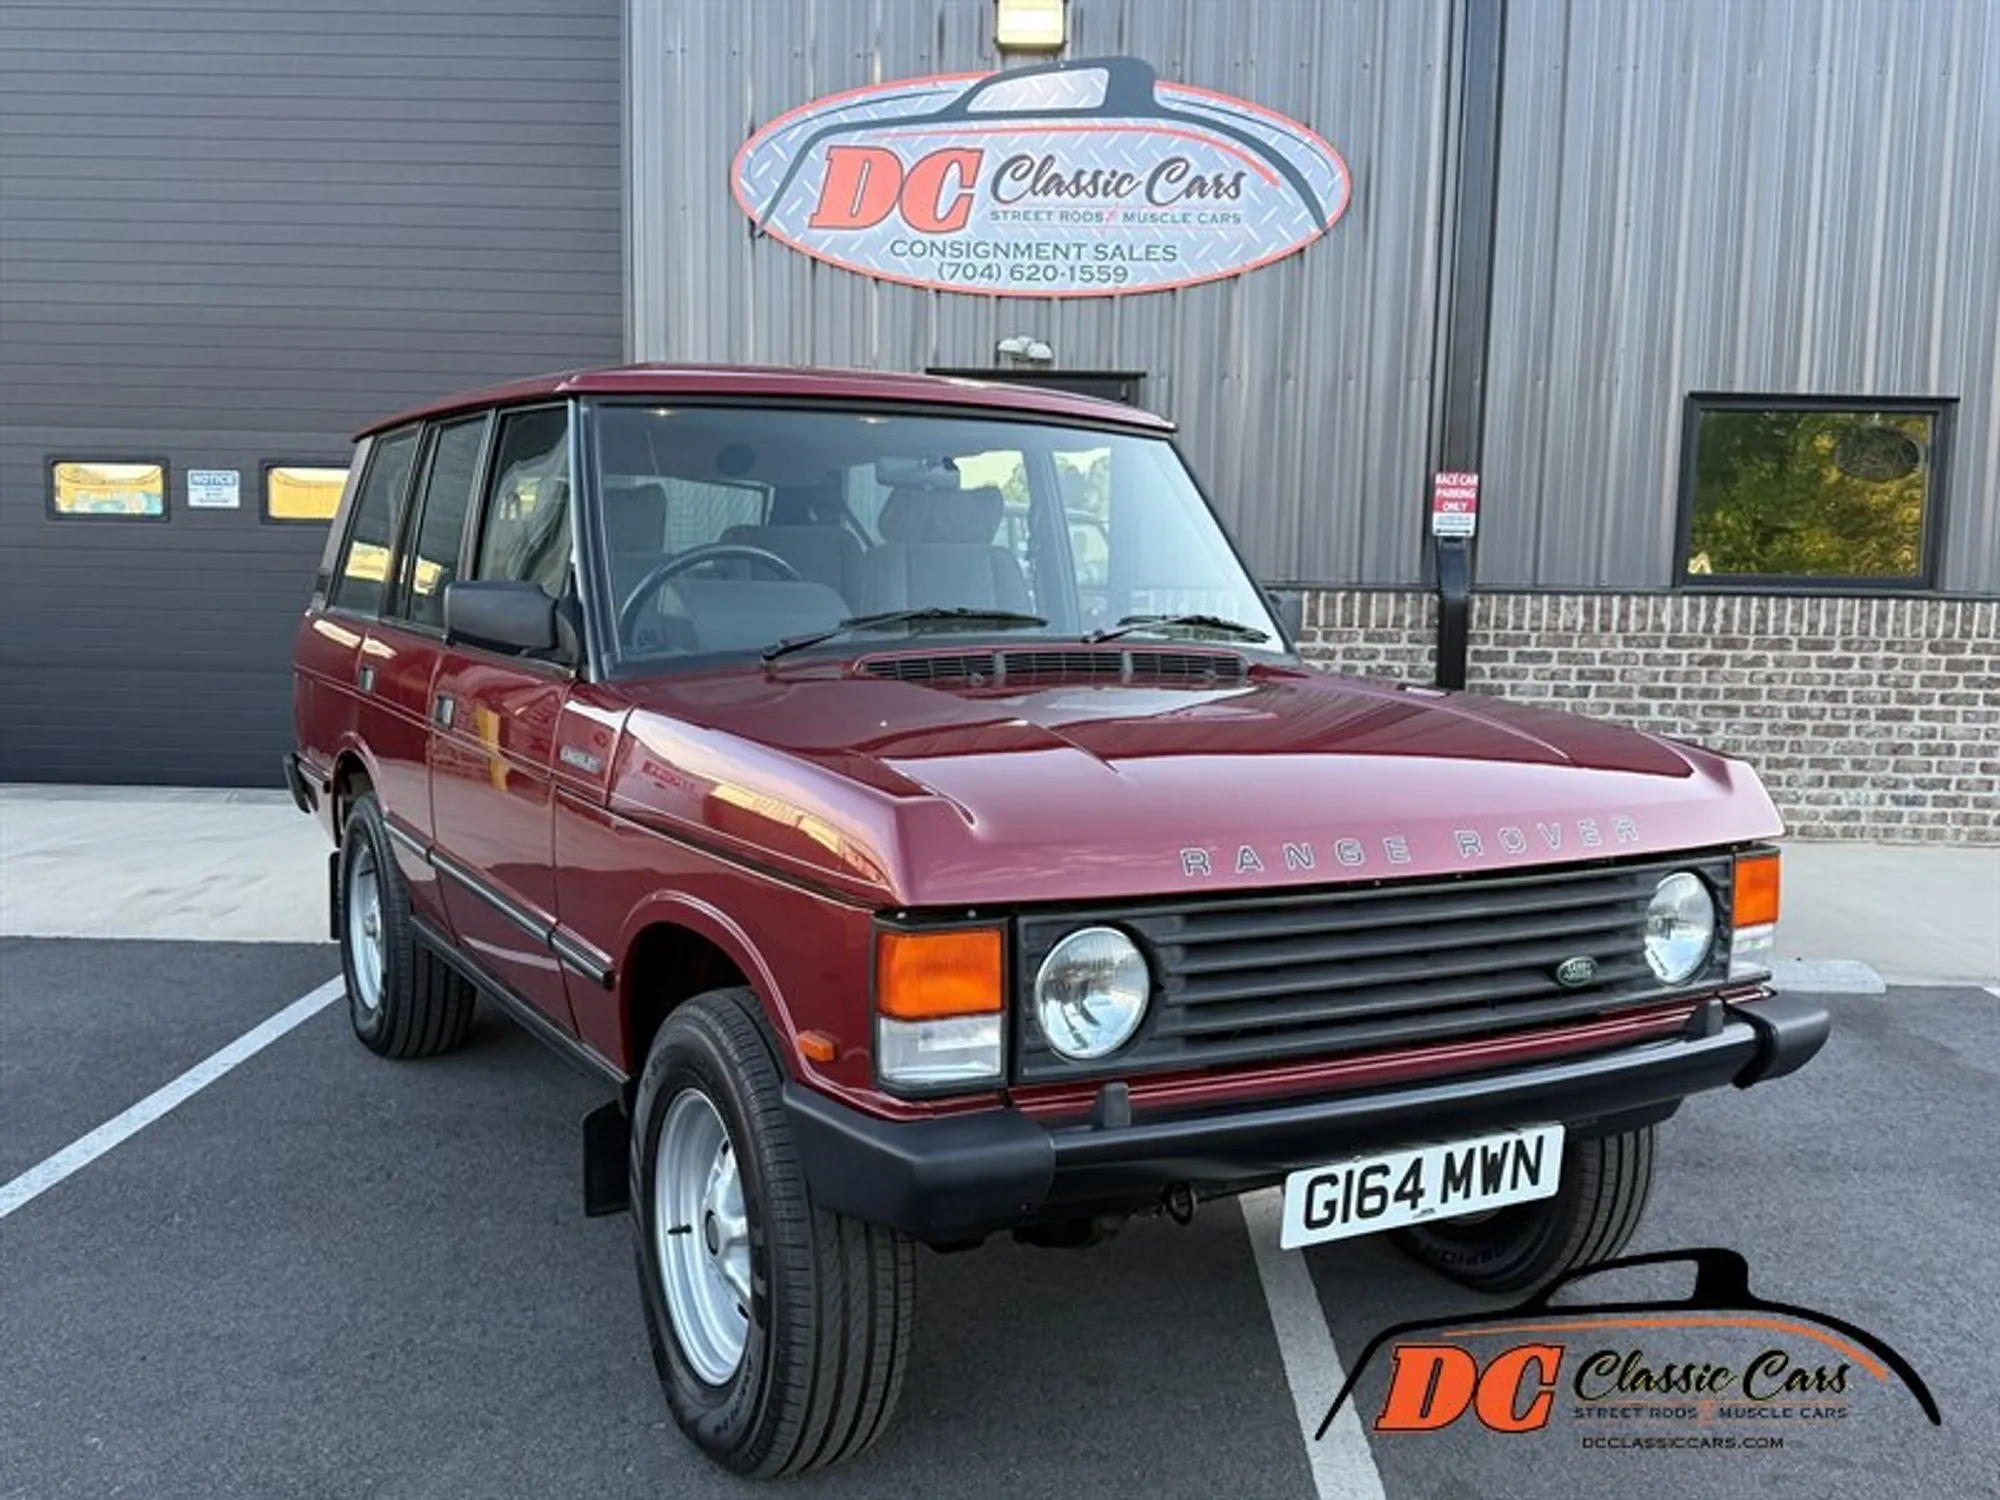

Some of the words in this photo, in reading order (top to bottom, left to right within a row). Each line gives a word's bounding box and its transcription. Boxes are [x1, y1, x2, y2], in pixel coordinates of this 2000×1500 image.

[808, 145, 984, 233] DC
[990, 154, 1142, 205] Classic
[1145, 156, 1247, 206] Cars
[990, 210, 1052, 222] STREET
[1059, 210, 1103, 223] RODS
[1122, 211, 1191, 224] MUSCLE
[1197, 213, 1242, 224] CARS
[890, 239, 1088, 261] CONSIGNMENT
[1093, 244, 1178, 262] SALES
[938, 262, 1001, 282] (704)
[1009, 264, 1129, 284] 620-1559
[1180, 837, 1412, 876] RANGE
[1454, 814, 1640, 859] ROVER
[1304, 1157, 1425, 1230] G164
[1440, 1135, 1544, 1204] MWN
